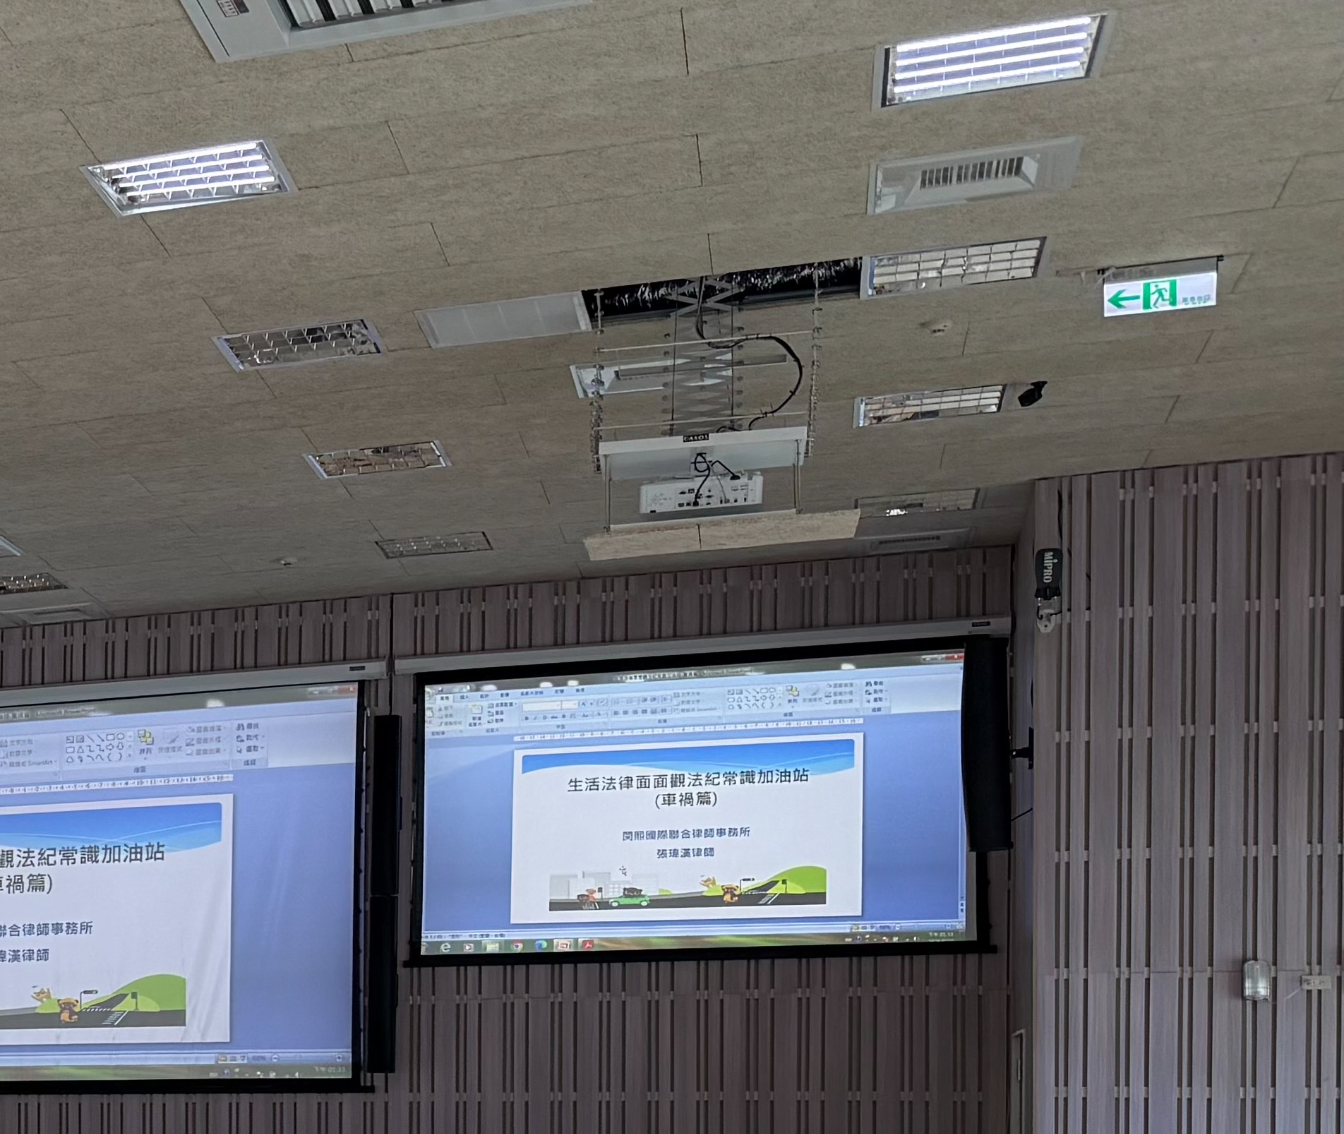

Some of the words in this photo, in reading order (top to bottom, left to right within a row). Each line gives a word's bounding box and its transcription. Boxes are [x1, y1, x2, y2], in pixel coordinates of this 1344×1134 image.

[567, 768, 810, 793] 生活法律面面觀法紀常識加油站
[655, 791, 717, 809] (車禍篇)
